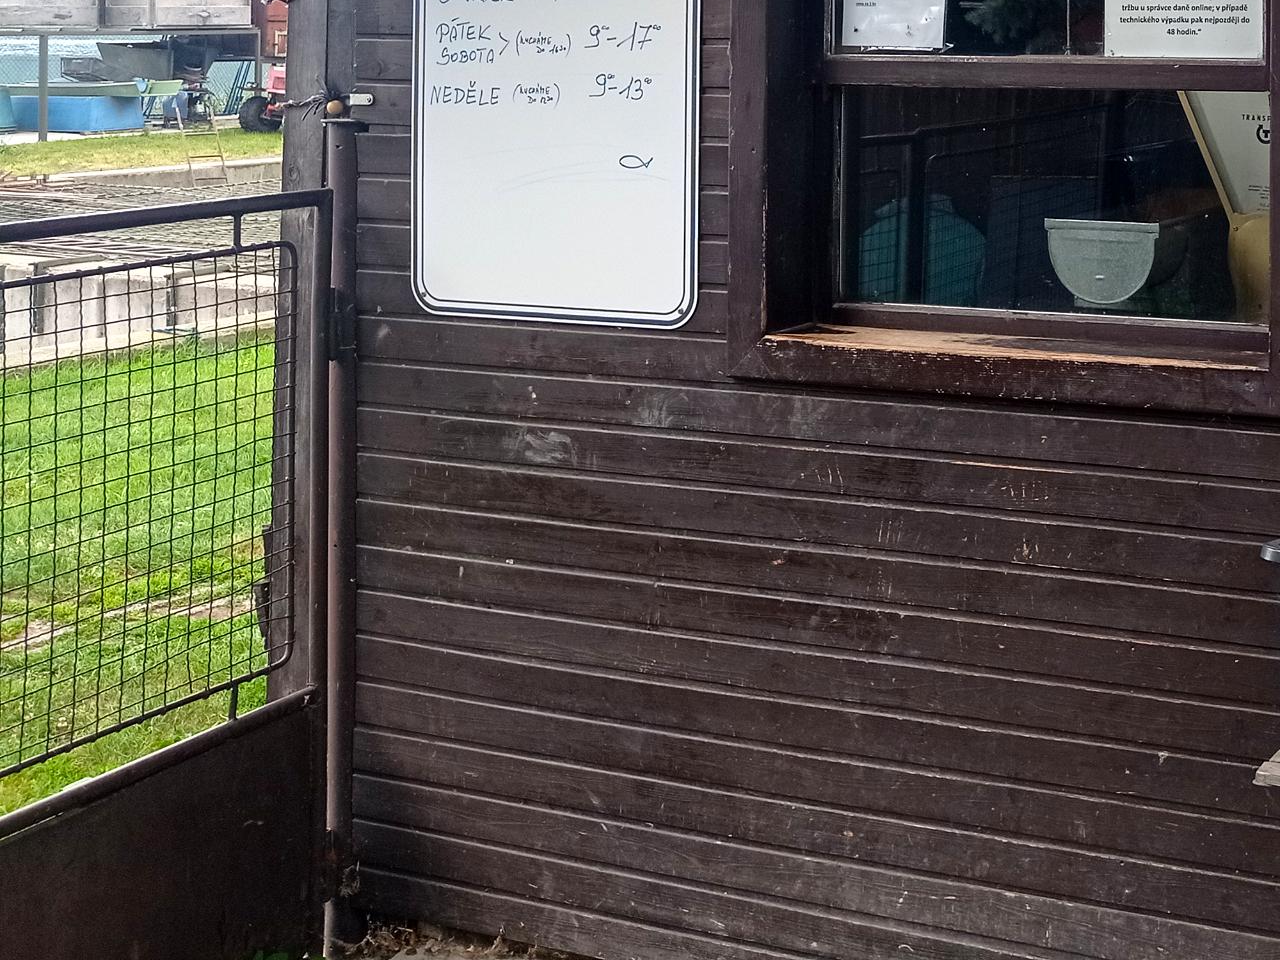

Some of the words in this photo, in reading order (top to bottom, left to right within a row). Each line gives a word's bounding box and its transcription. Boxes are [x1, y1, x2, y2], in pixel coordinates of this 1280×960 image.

[1146, 4, 1172, 13] správce
[1221, 4, 1248, 13] případě
[436, 17, 492, 43] PÁTEK
[1119, 16, 1160, 24] technického
[1161, 16, 1189, 25] výpadku
[1190, 16, 1203, 25] pak
[1204, 16, 1240, 25] nejpozději
[1240, 16, 1250, 24] do
[436, 47, 495, 66] SOBOTA
[430, 81, 501, 106] NEDĚLE
